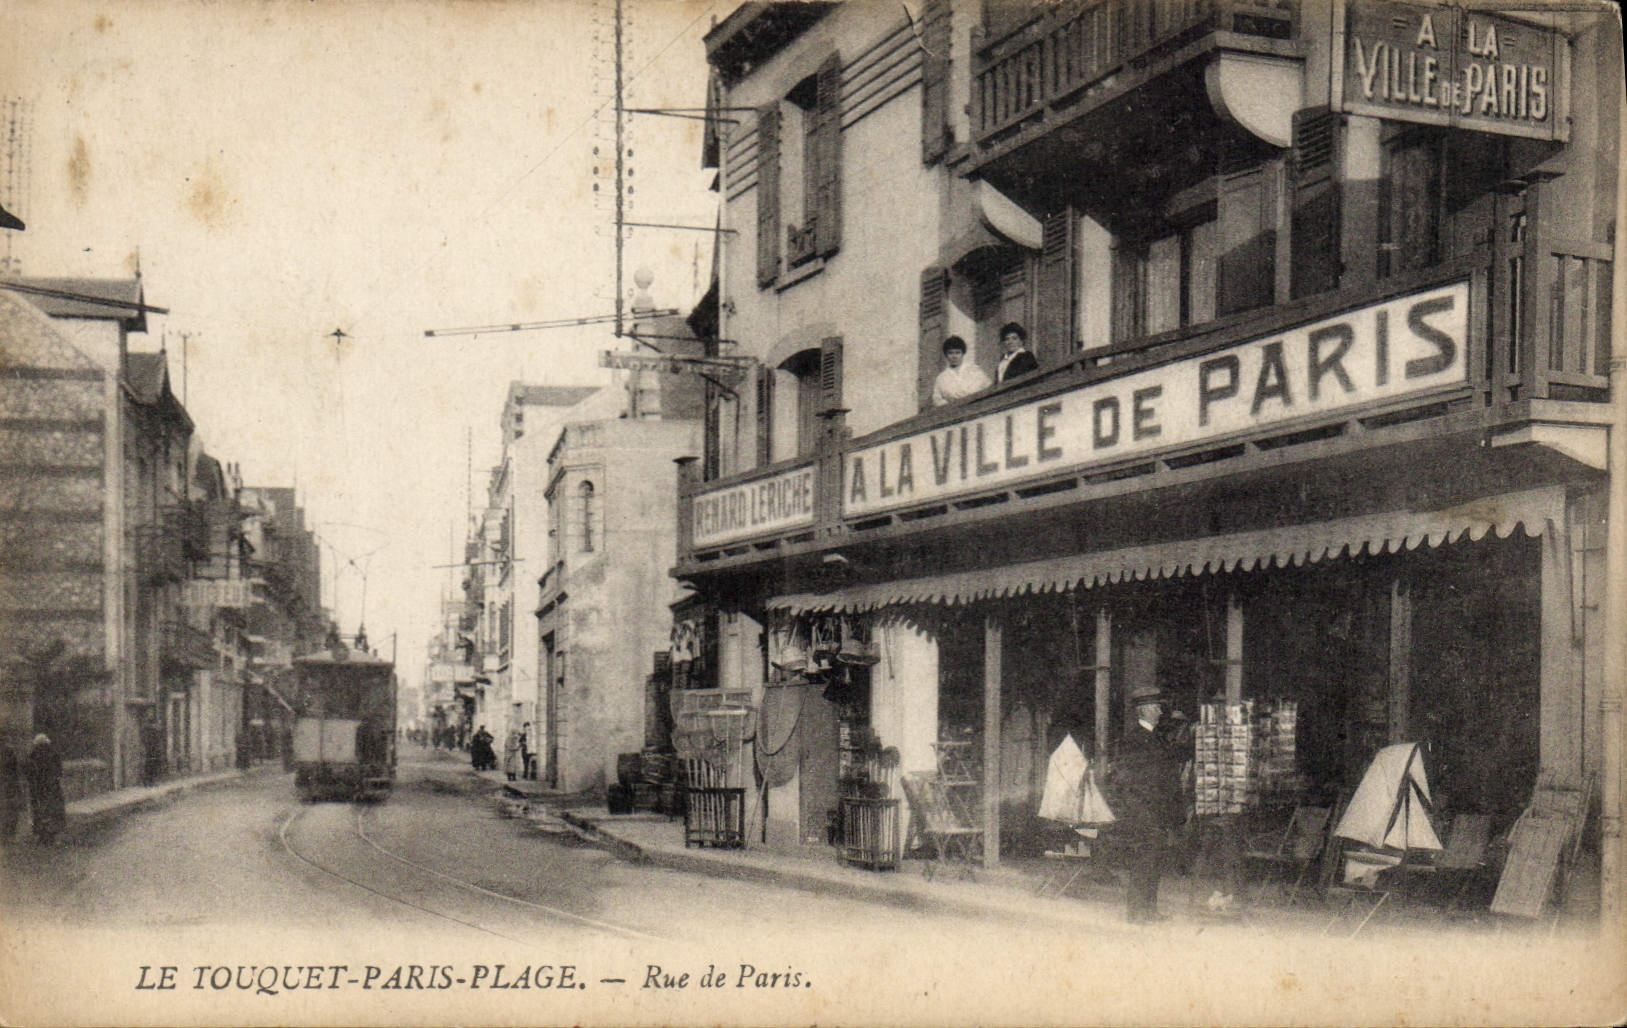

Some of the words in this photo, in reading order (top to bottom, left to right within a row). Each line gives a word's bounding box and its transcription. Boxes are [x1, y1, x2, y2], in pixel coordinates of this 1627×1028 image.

[1416, 13, 1437, 49] A
[1468, 21, 1499, 58] LA
[1353, 36, 1438, 105] VILLE
[1442, 82, 1460, 107] DE
[1461, 62, 1548, 120] PARIS
[850, 456, 867, 504] A
[880, 443, 914, 498] LA
[930, 401, 1062, 486] VILLE
[1093, 385, 1162, 449] DE
[1199, 295, 1458, 427] PARIS
[751, 472, 811, 525] LERICHE
